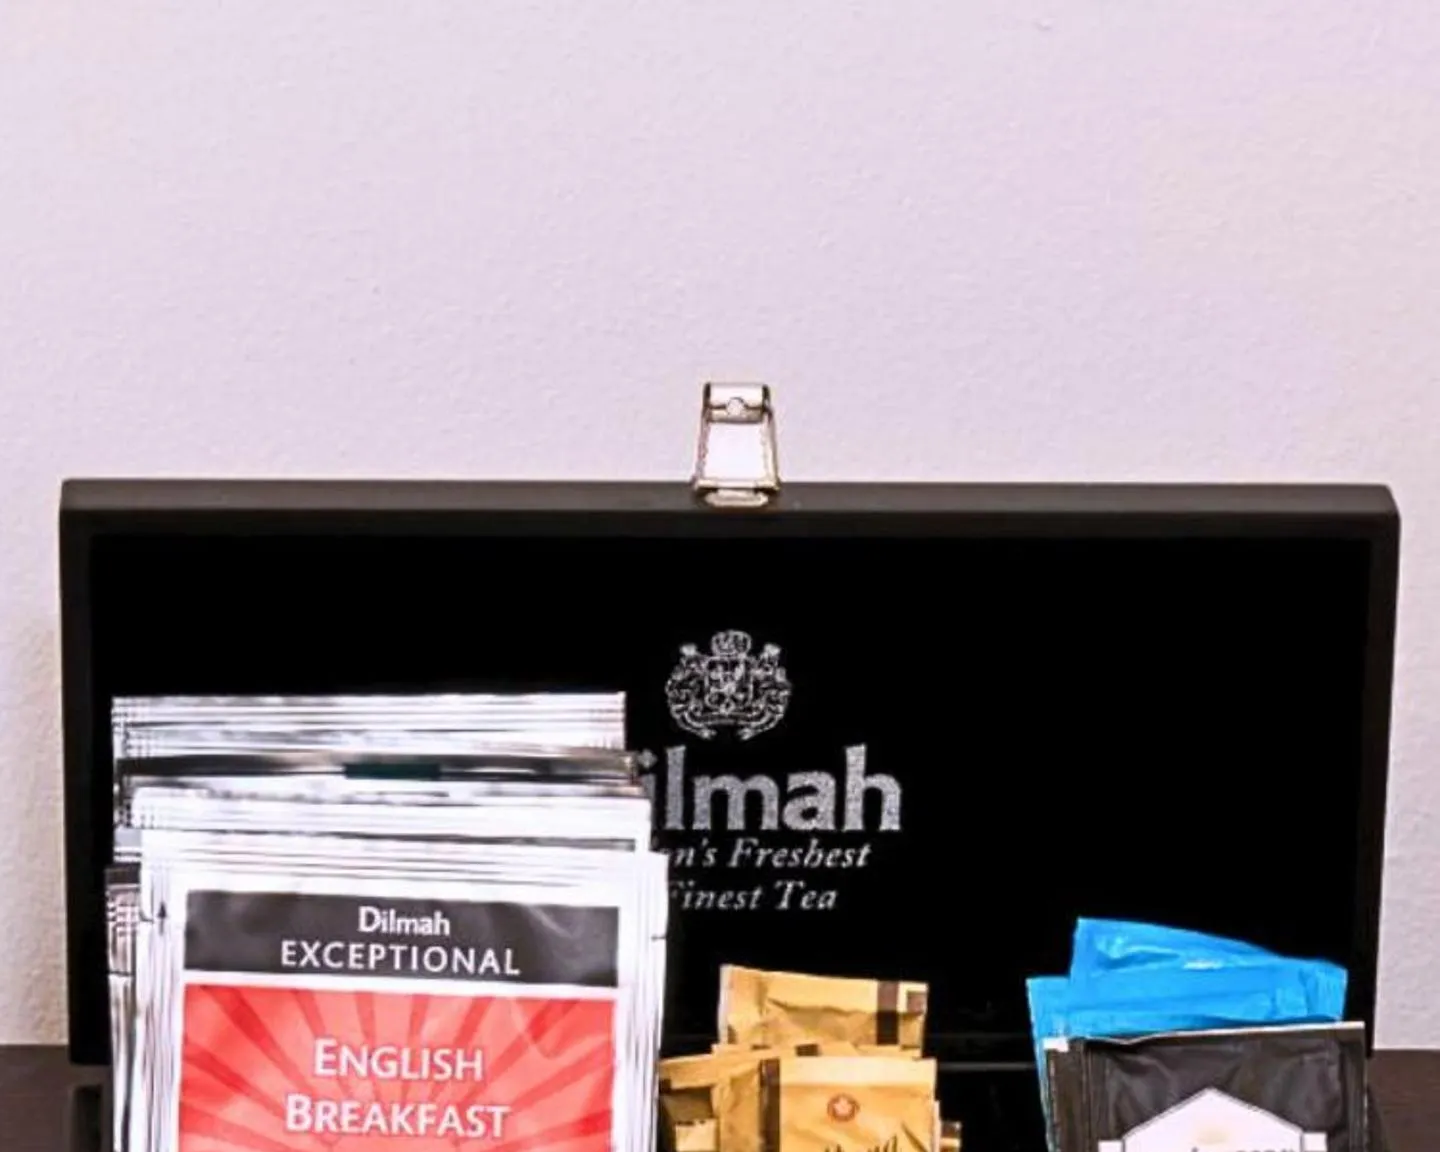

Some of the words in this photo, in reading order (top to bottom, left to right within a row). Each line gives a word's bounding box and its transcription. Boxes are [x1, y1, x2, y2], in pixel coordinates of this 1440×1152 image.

[727, 837, 873, 868] Freshest
[773, 880, 839, 910] Tea
[358, 906, 451, 937] Dilmah
[280, 940, 521, 976] EXCEPTIONAL
[313, 1037, 484, 1082] ENGLISH
[285, 1093, 511, 1139] BREAKFAST
